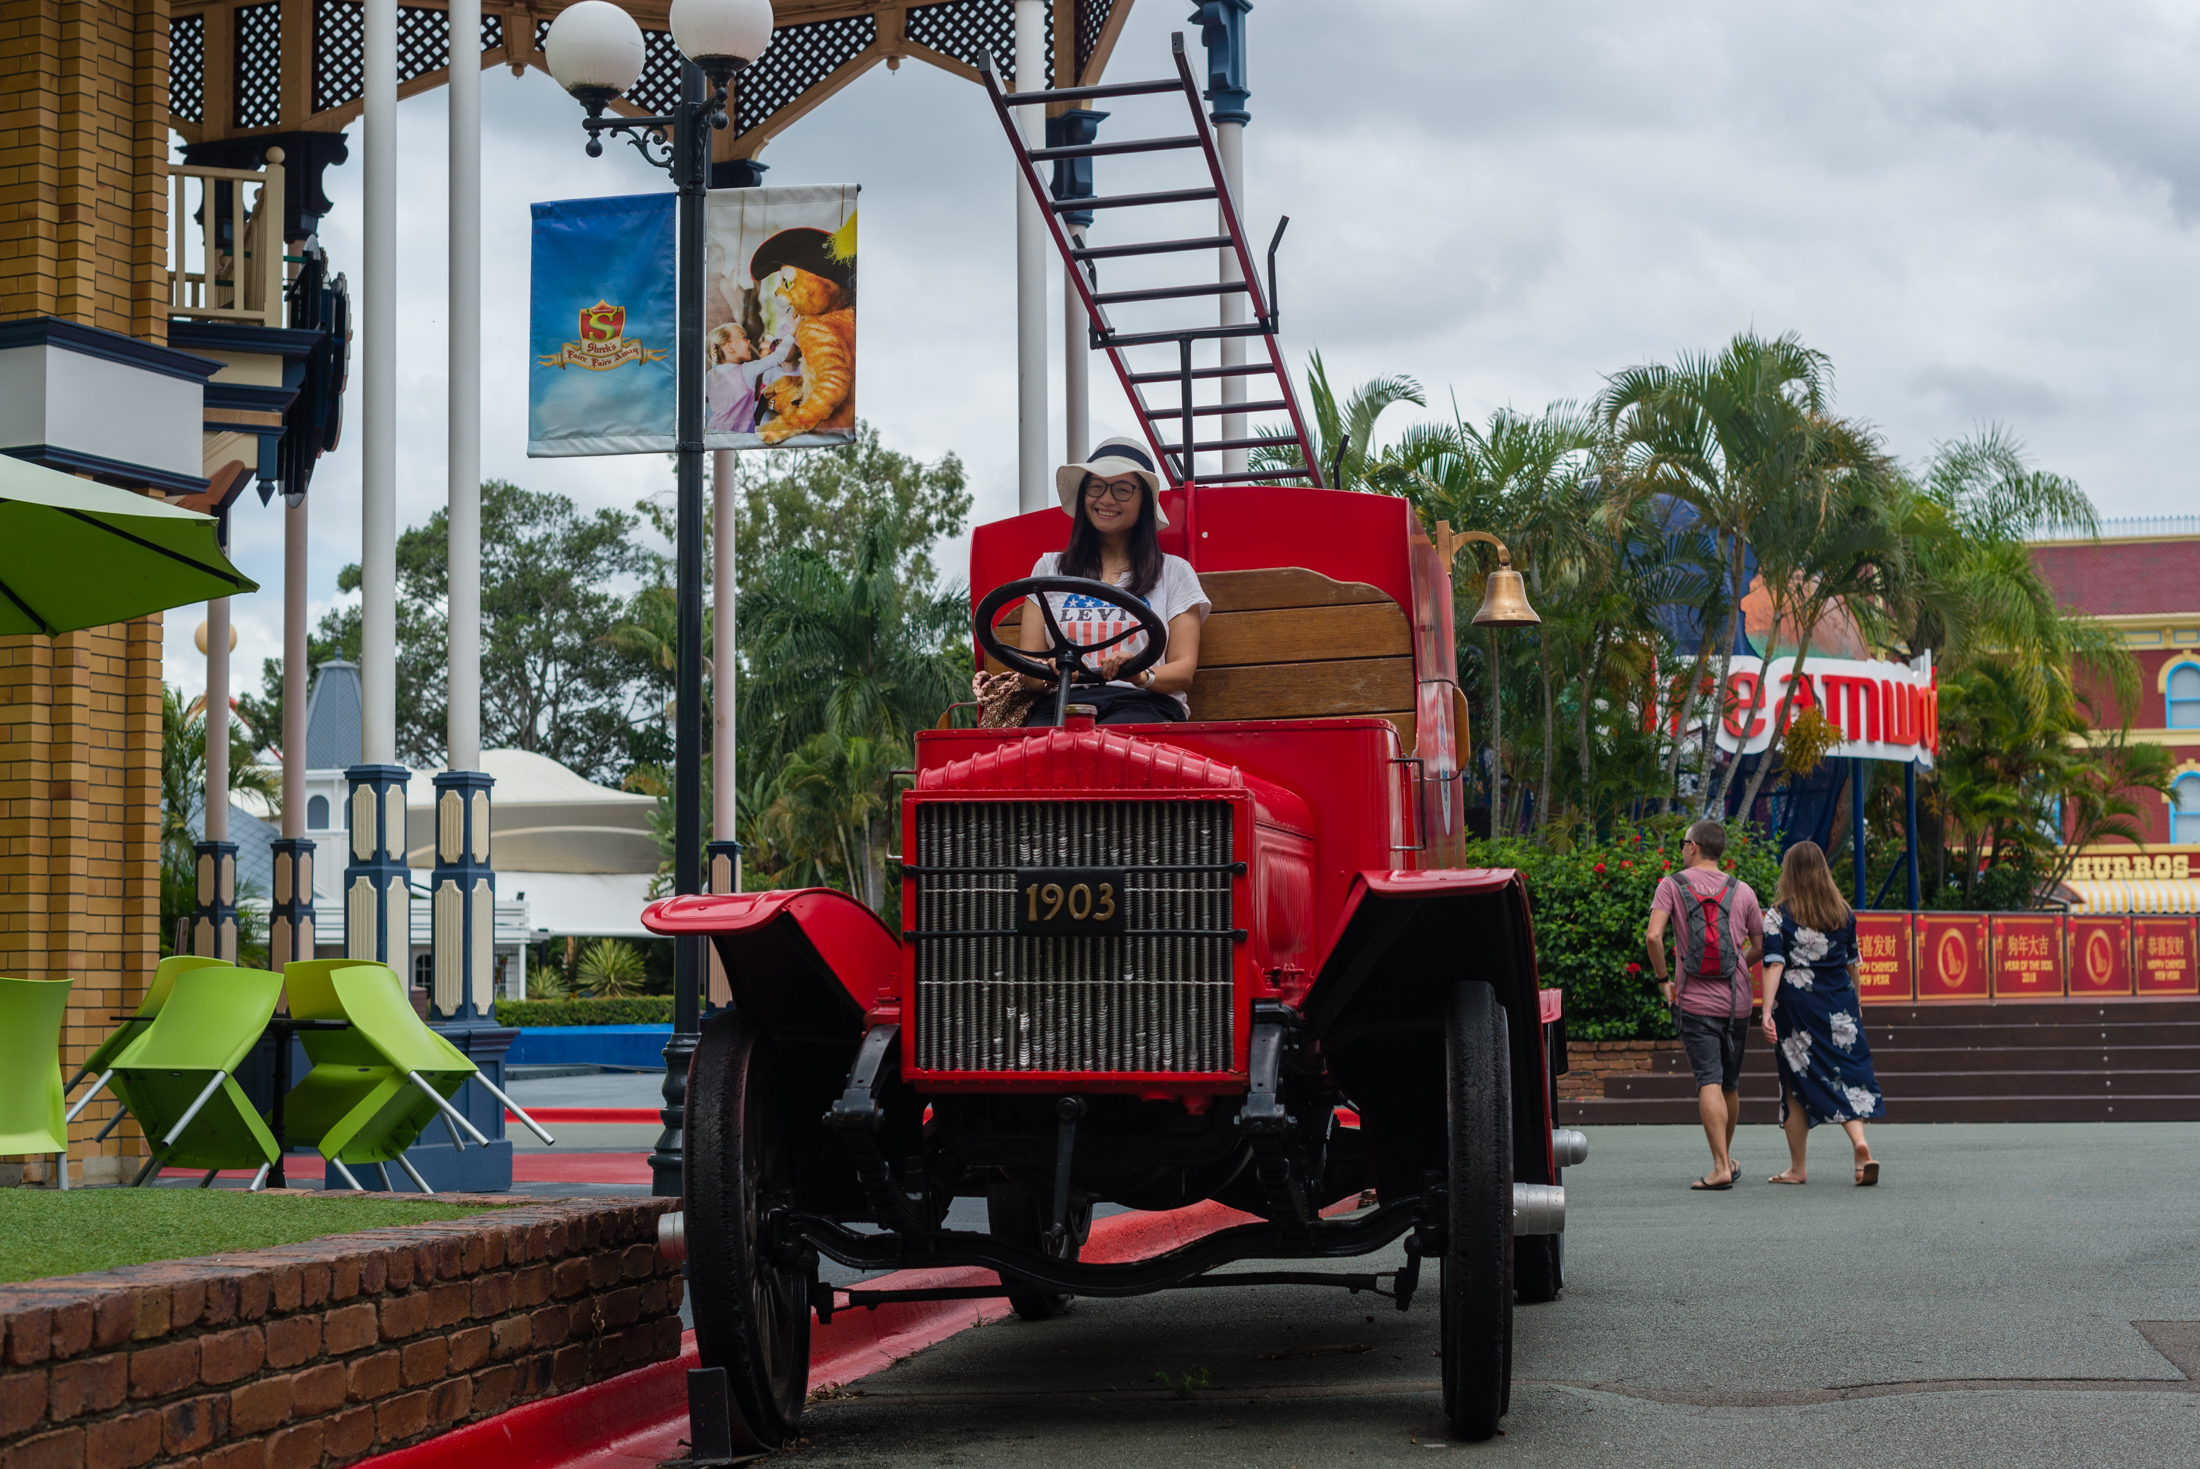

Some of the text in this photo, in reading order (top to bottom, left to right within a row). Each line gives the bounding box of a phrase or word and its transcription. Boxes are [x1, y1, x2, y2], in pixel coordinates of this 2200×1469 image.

[587, 342, 617, 354] Shrek's
[1026, 883, 1116, 922] 1903
[2008, 935, 2048, 956] 狗年大吉
[2147, 935, 2185, 956] 恭喜发财
[1871, 962, 1898, 972] CHINESE
[2004, 960, 2053, 972] YEAR OF THE DOG
[2147, 959, 2187, 970] HAPPY CHINESE
[1873, 975, 1890, 985] YEAR
[2021, 972, 2037, 984] 2018
[2154, 970, 2181, 981] NEW YEAR
